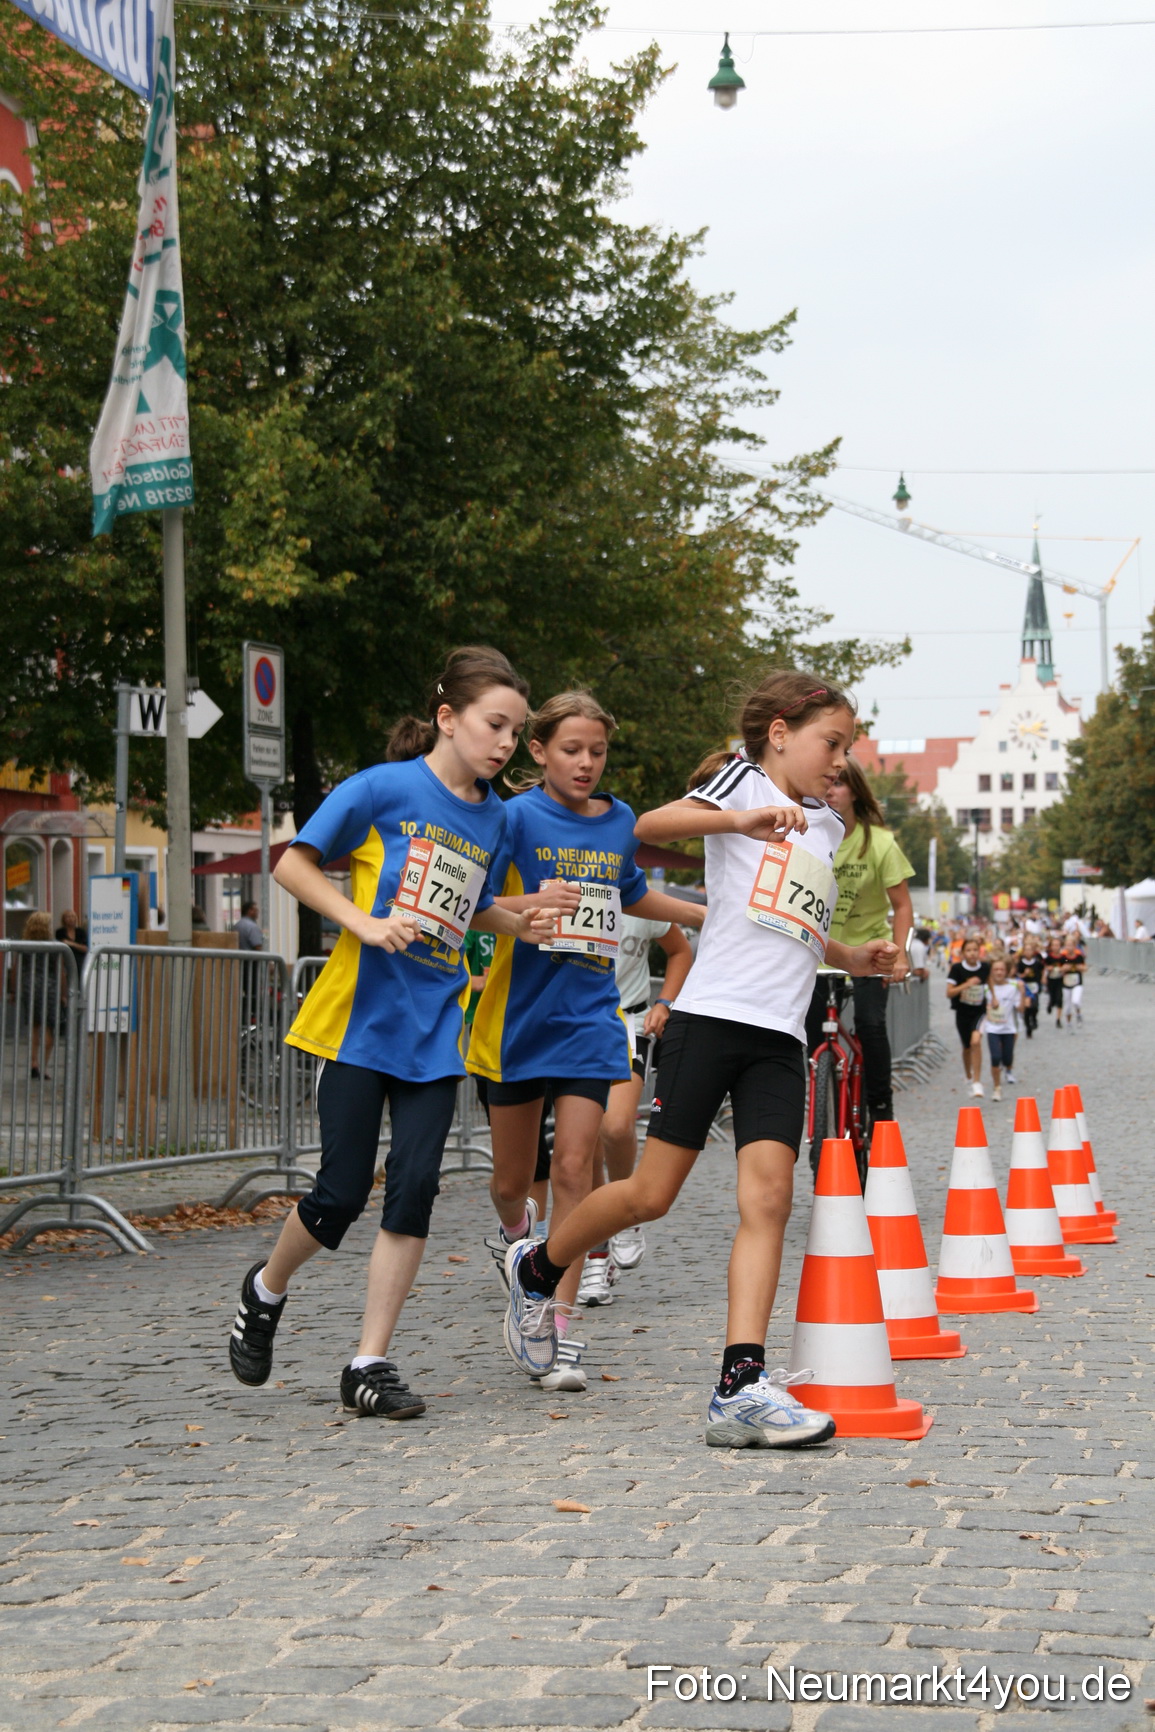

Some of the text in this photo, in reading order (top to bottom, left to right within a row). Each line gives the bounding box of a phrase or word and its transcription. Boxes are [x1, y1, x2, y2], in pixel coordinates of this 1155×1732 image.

[257, 709, 274, 723] ZONE
[399, 821, 421, 836] 10.
[424, 822, 490, 865] NEUMARK
[535, 847, 556, 861] 10.
[433, 854, 467, 883] Amelie
[428, 880, 471, 923] 7212
[788, 880, 831, 932] 7293
[570, 905, 616, 933] 7213
